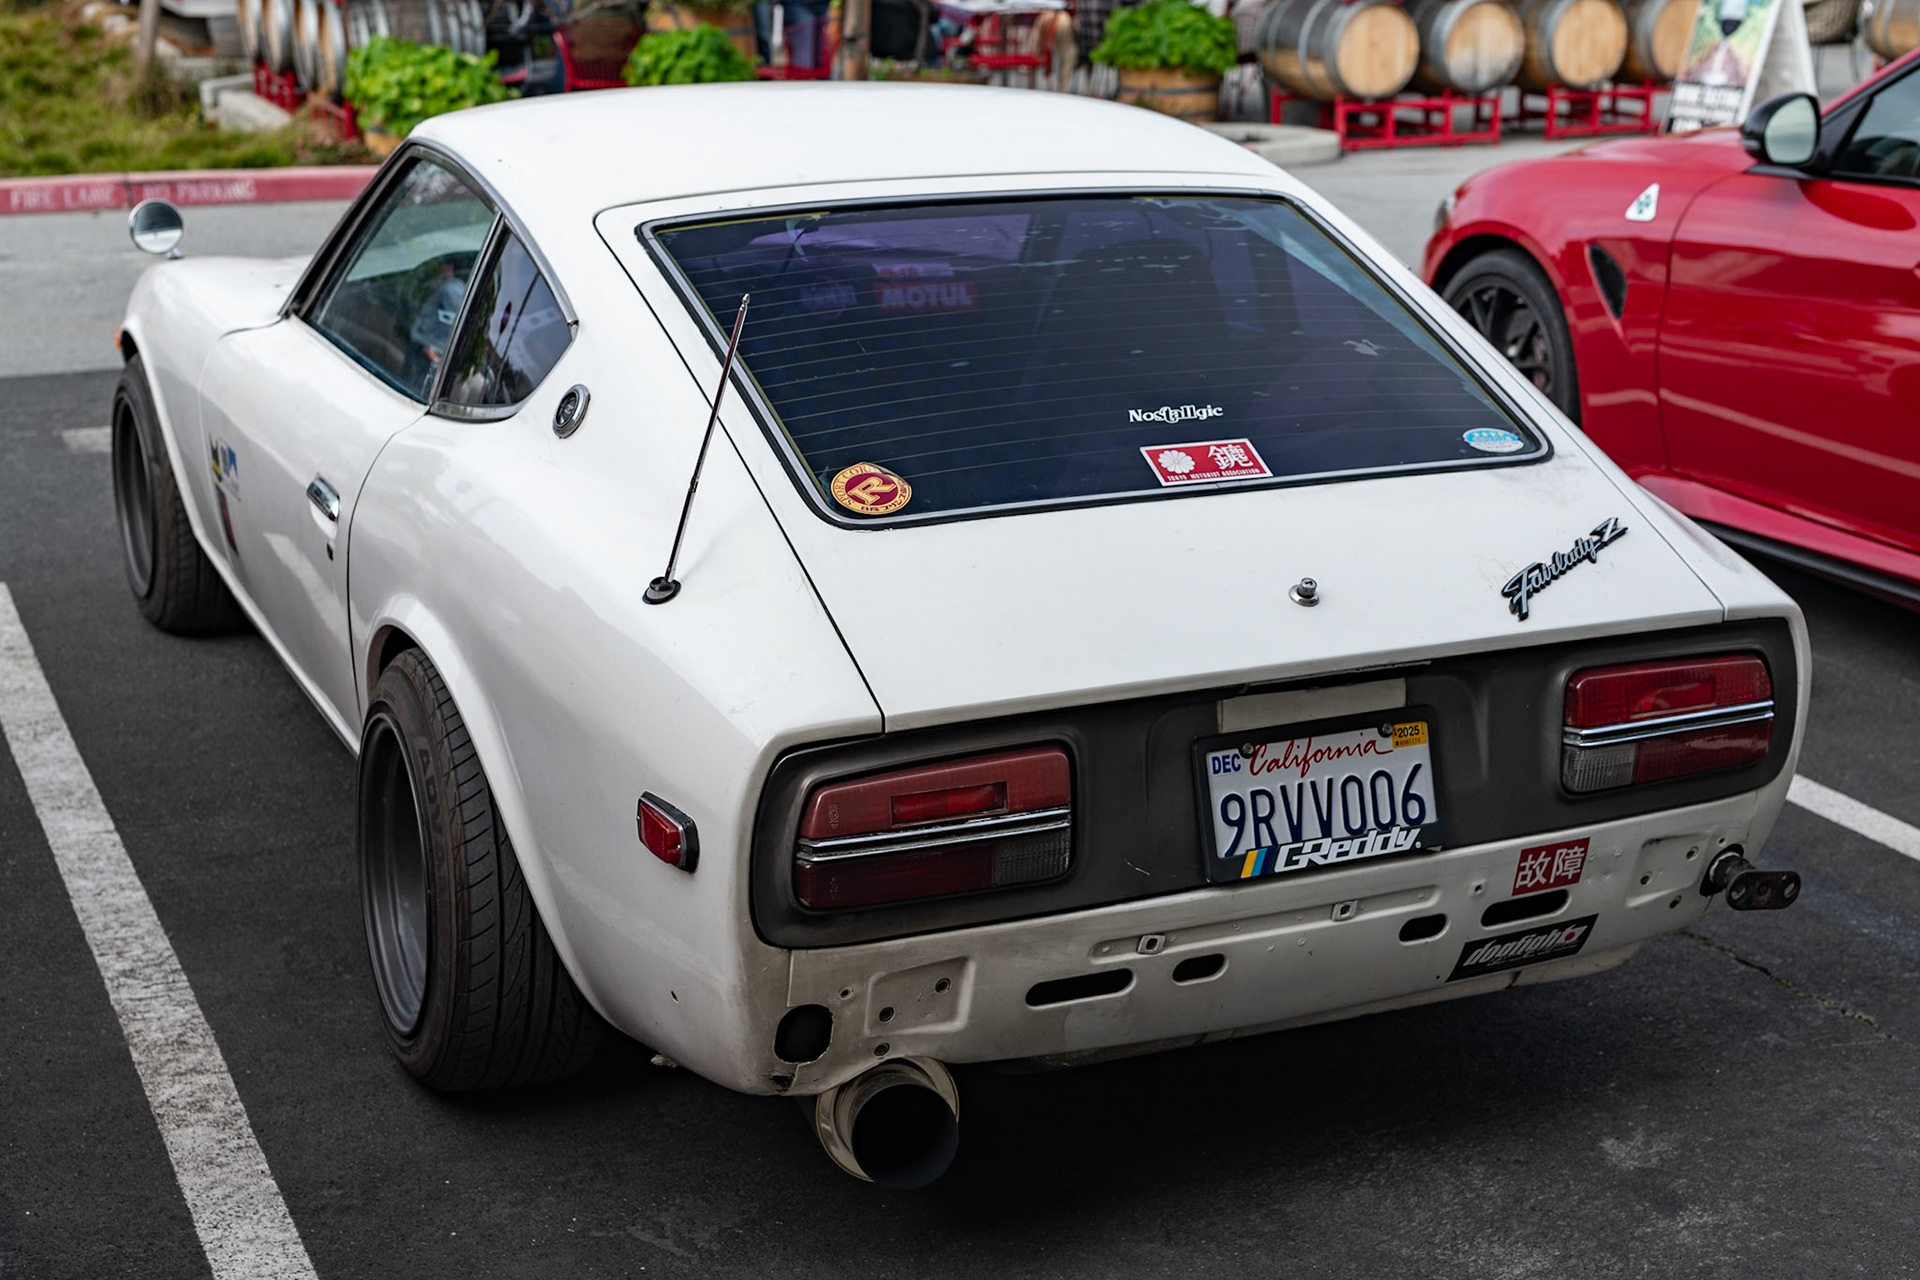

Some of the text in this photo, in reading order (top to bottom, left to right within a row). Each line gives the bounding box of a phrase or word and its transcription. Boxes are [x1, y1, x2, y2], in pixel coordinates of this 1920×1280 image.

[10, 187, 56, 210] FIRE
[64, 184, 115, 207] LANE
[881, 282, 972, 308] MOTUL
[1397, 725, 1420, 738] 2025
[1211, 753, 1241, 775] DEC
[1250, 733, 1394, 778] California
[1220, 763, 1427, 858] 9RVV006
[1515, 846, 1585, 889] 故障
